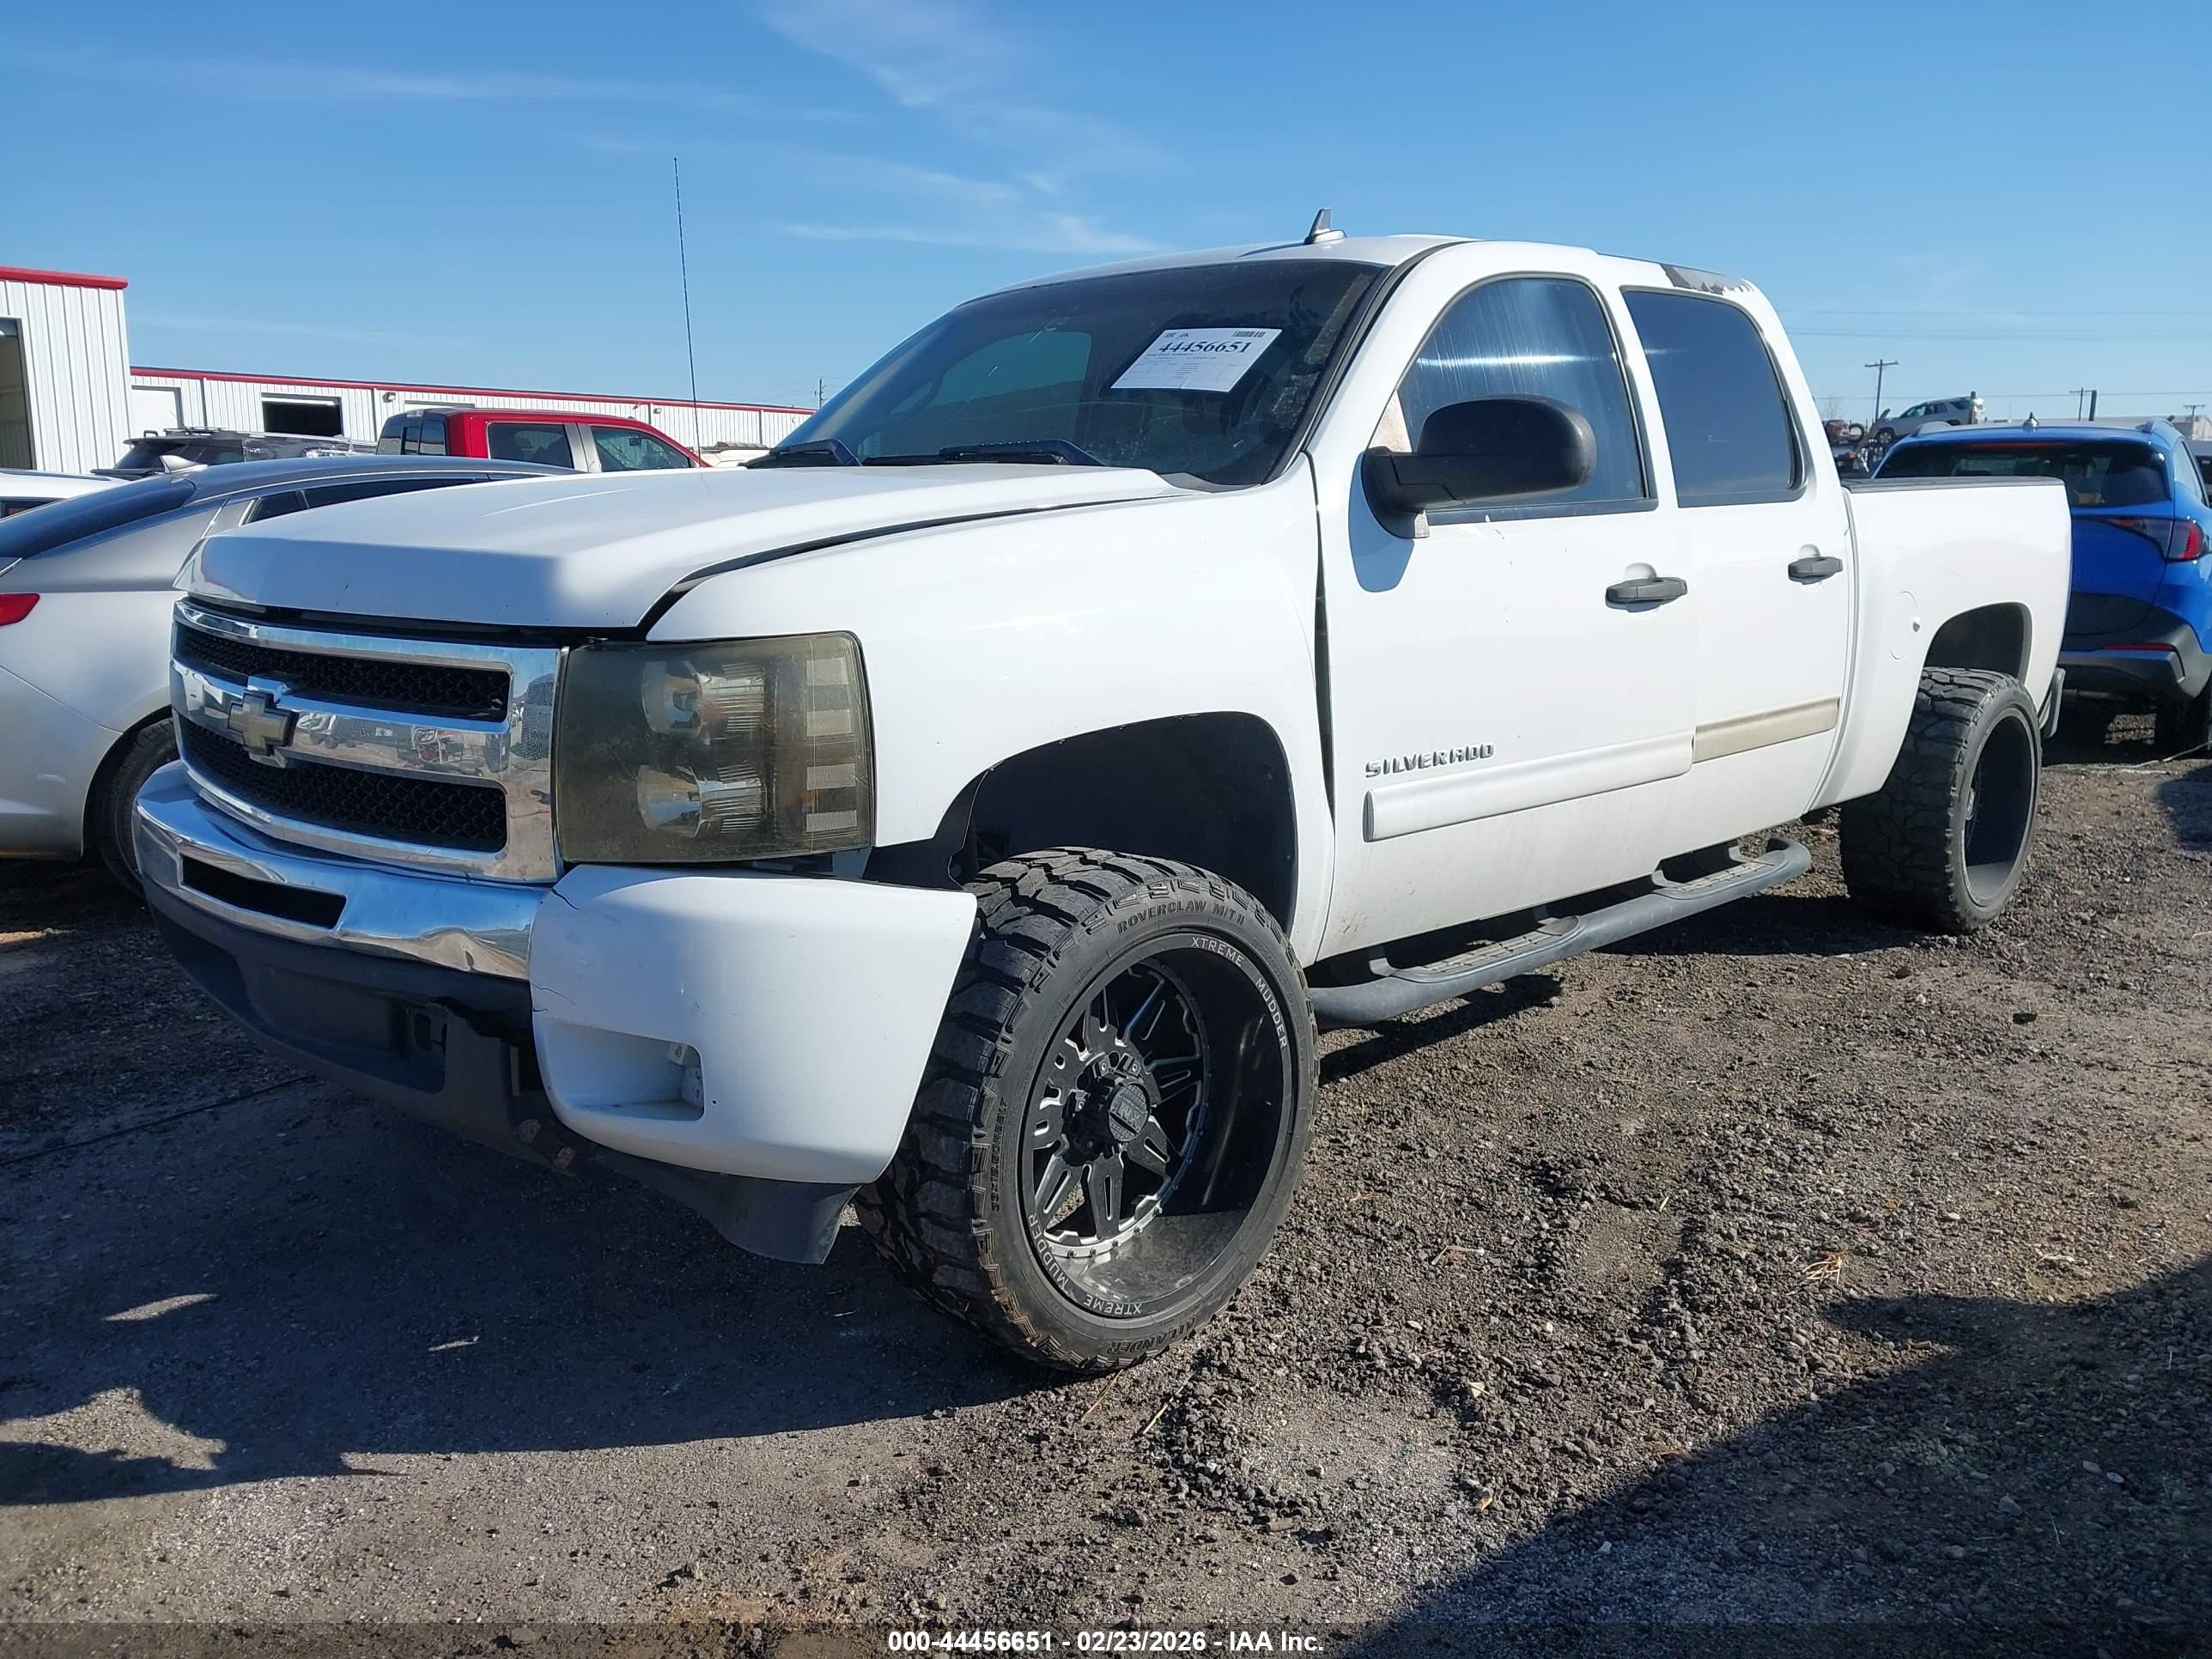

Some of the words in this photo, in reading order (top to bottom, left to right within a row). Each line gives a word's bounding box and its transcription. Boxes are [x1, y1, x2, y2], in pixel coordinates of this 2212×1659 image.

[1158, 340, 1252, 353] 44456651
[1365, 743, 1495, 779] SILVERADO
[1117, 900, 1206, 934] ROVERCLAW
[1212, 902, 1236, 920] M/T
[1191, 936, 1244, 967] XTREME
[1255, 977, 1288, 1050] MUDDER
[1028, 1212, 1070, 1293] MUDDER
[1084, 1293, 1142, 1316] XTREME
[1106, 1317, 1196, 1355] ATLANDER
